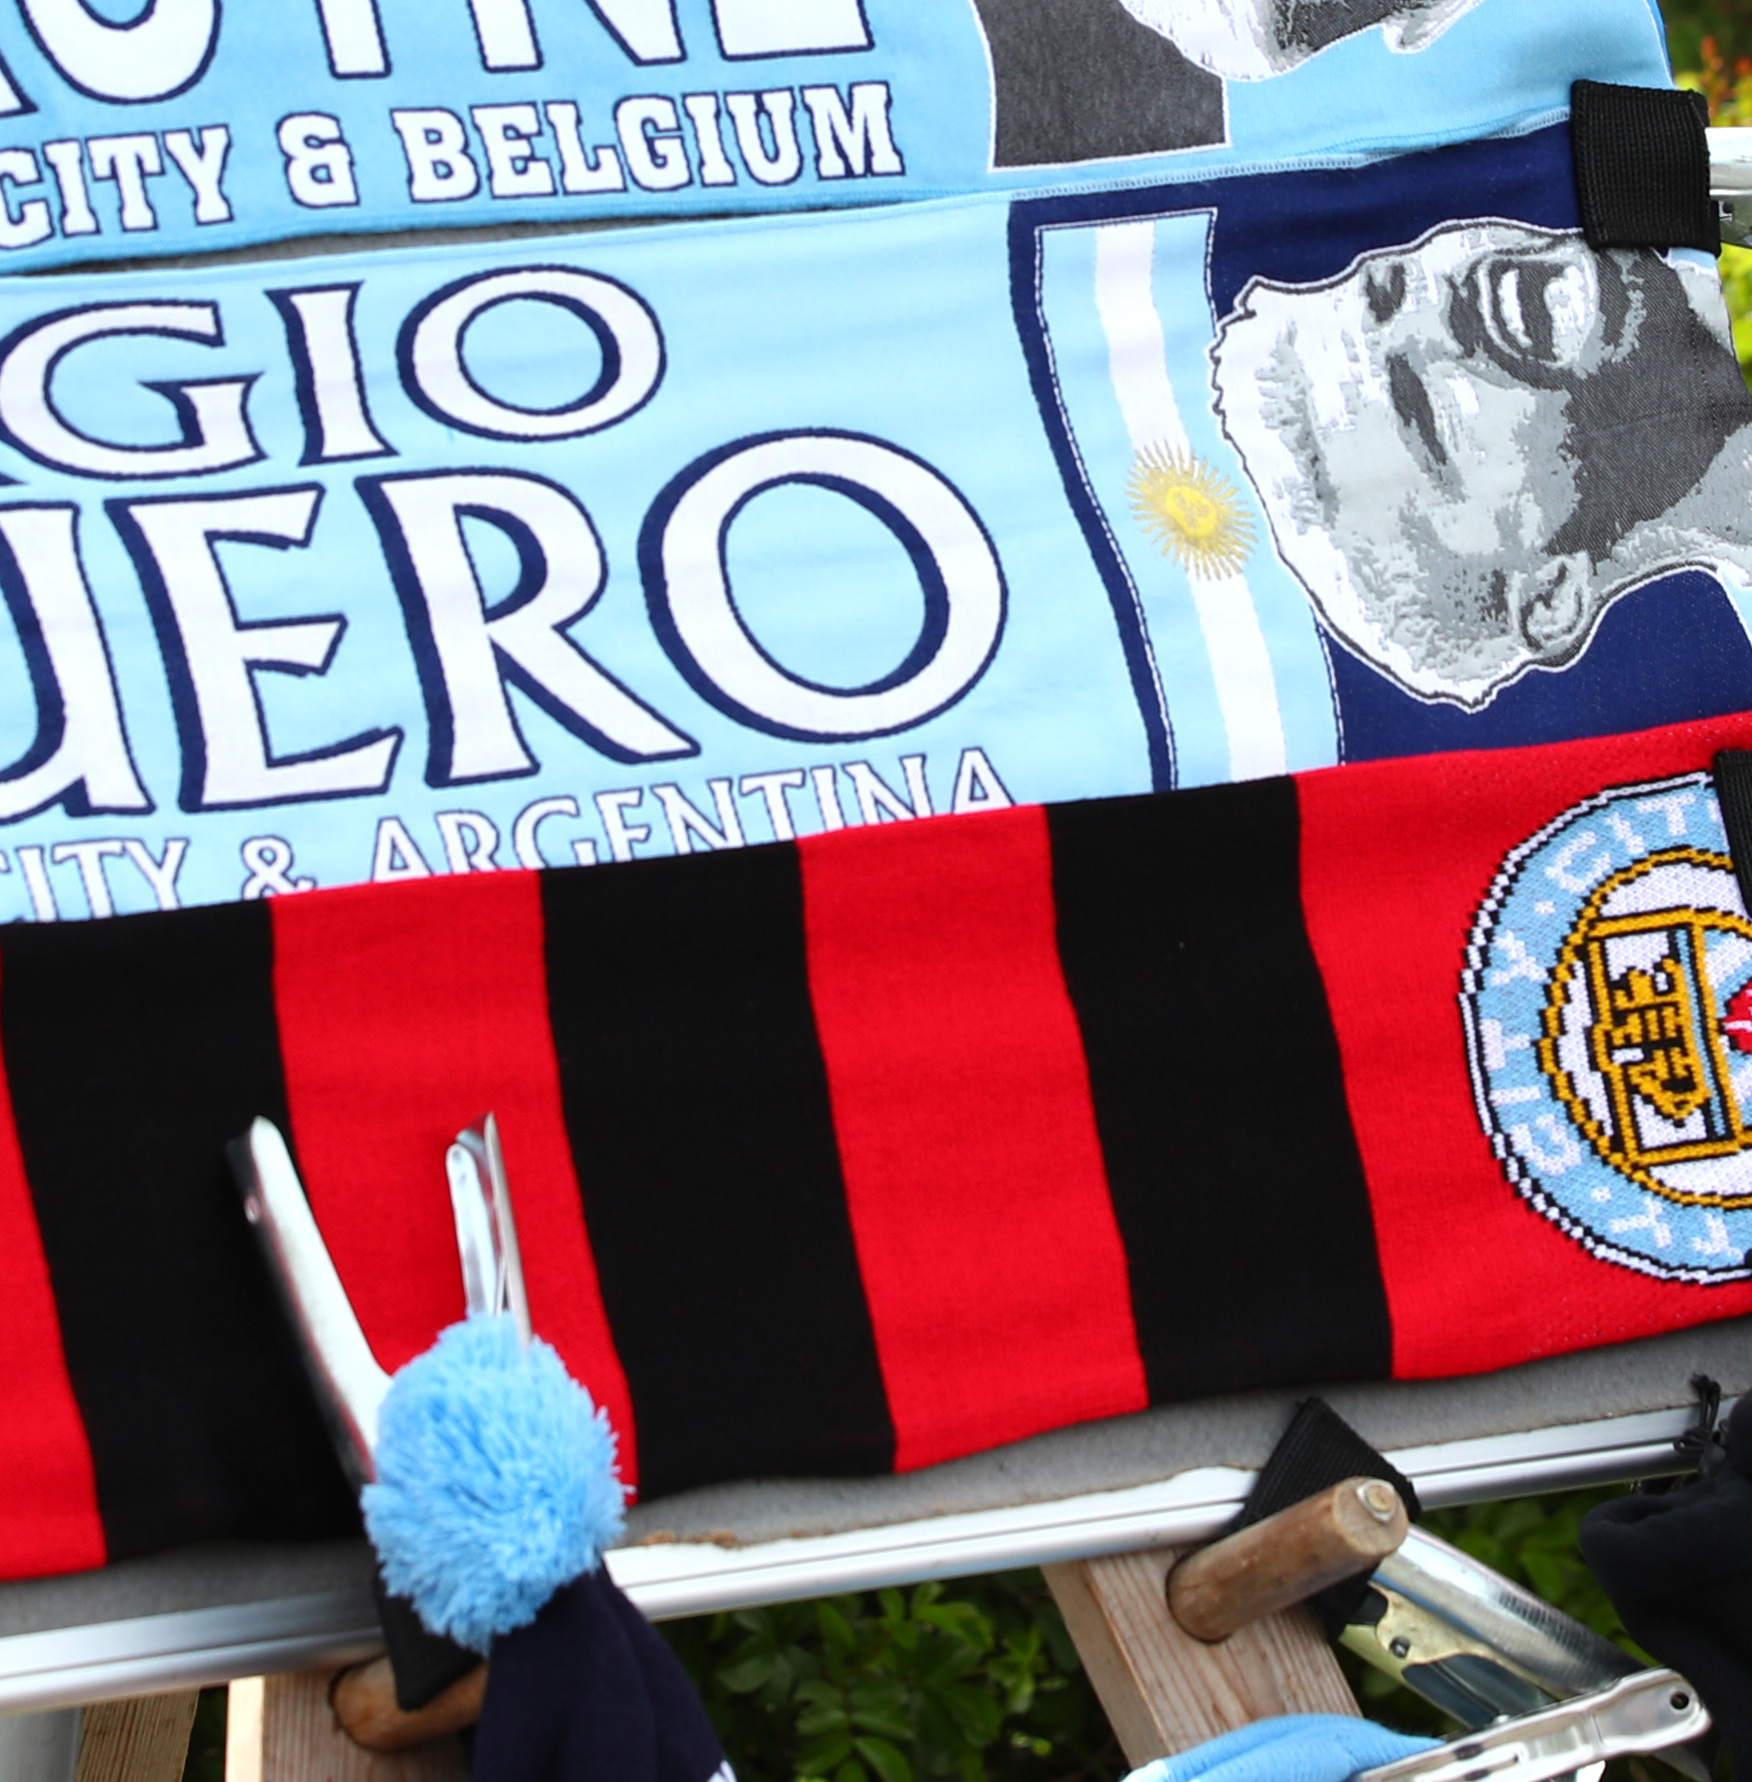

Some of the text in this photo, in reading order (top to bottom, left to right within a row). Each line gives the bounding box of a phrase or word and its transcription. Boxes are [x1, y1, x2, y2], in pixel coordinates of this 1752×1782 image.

[275, 111, 359, 208] &
[389, 79, 907, 204] BELGIUM
[238, 833, 317, 900] &
[369, 746, 1017, 884] ARGENTINA
[1548, 792, 1729, 895] CIT
